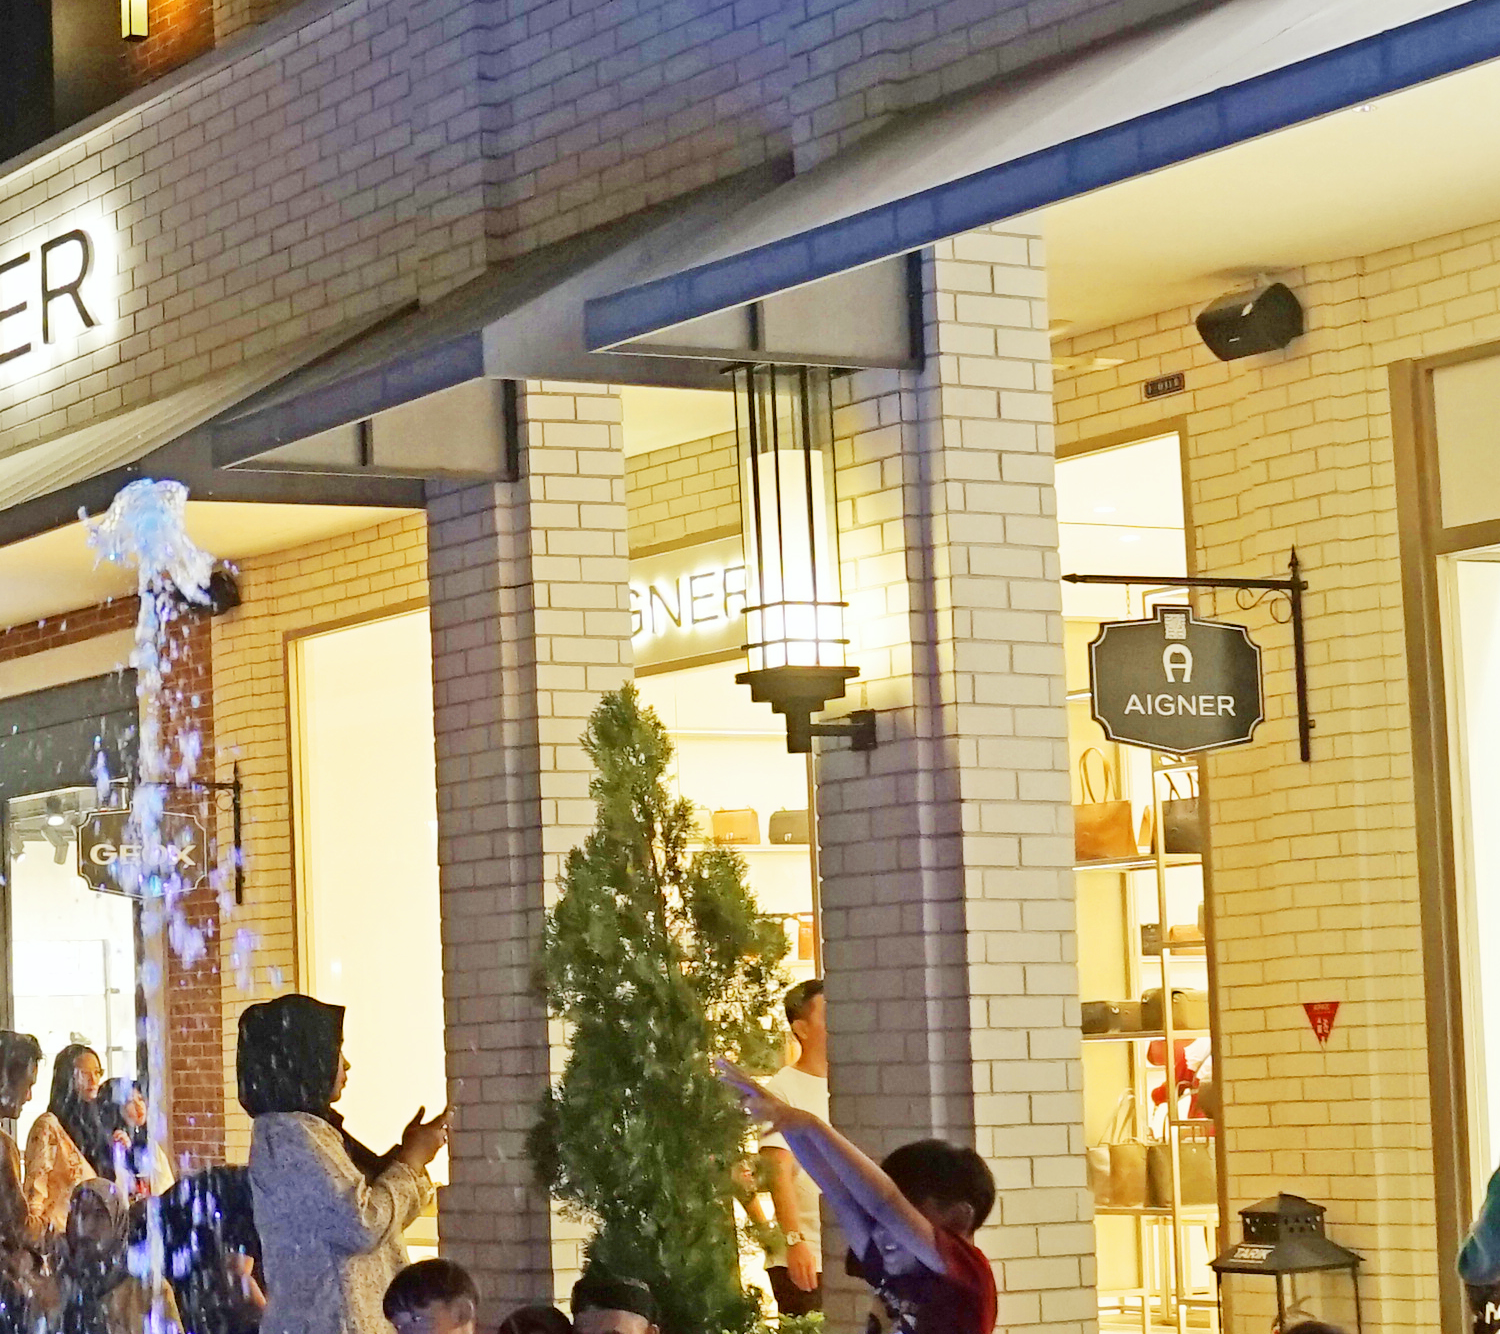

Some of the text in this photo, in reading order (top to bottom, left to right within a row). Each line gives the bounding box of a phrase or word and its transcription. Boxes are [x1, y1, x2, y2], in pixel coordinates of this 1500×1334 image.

[629, 564, 747, 637] GNER
[1123, 693, 1237, 717] AIGNER
[89, 843, 197, 867] GEOX
